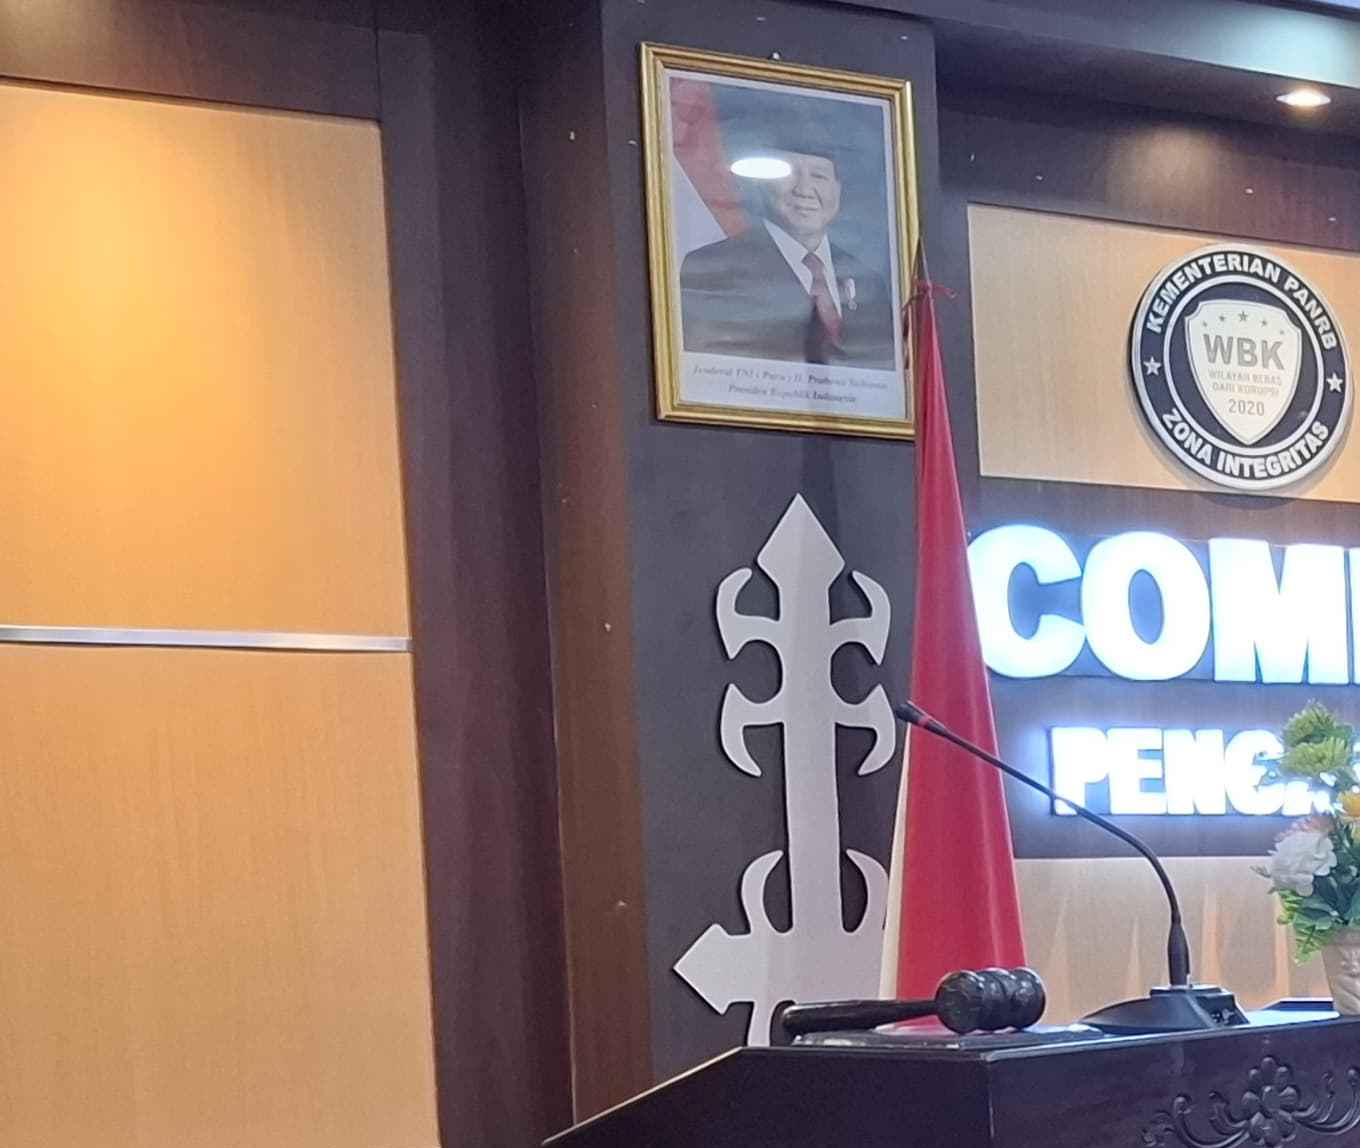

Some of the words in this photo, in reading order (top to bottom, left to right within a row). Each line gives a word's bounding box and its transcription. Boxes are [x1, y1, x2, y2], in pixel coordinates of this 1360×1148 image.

[1147, 254, 1281, 334] KEMENTERIAN
[1284, 276, 1337, 350] PANRB
[1203, 333, 1285, 370] WBK
[1228, 398, 1265, 417] 2020
[1162, 407, 1214, 466] ZONA
[1216, 421, 1330, 479] INTEGRITAS
